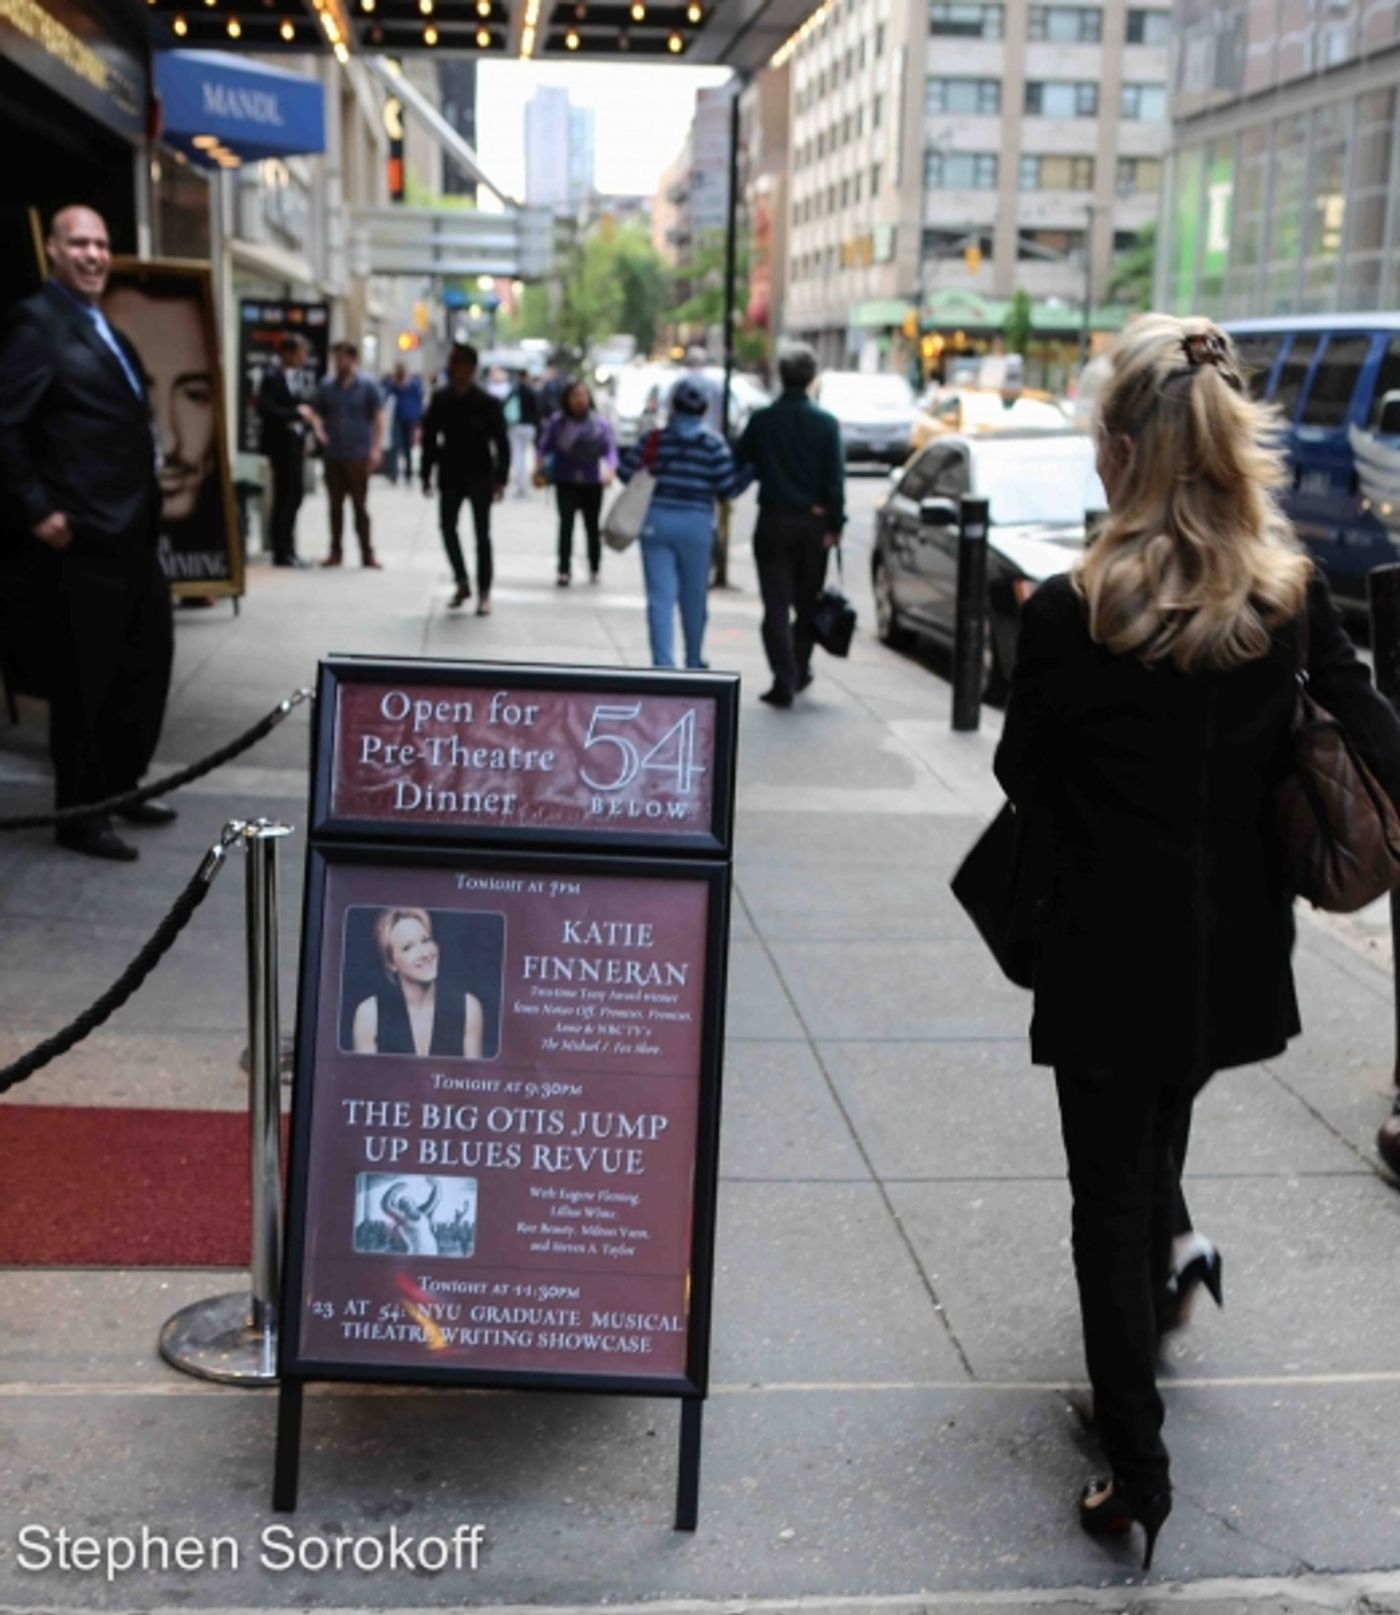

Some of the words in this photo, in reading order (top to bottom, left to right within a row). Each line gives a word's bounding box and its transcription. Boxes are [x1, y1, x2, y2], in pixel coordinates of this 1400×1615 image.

[380, 691, 475, 733] Open
[488, 691, 540, 726] for
[359, 734, 556, 771] Pre-Theatre
[579, 701, 706, 793] 54
[394, 777, 518, 815] Dinner
[591, 797, 689, 819] BELOW
[562, 920, 655, 948] KATIE
[522, 955, 689, 987] FINNERAN
[341, 1099, 413, 1127] THE
[420, 1103, 479, 1131] BIG
[486, 1107, 565, 1136] OTIS
[571, 1111, 669, 1140] JUMP
[363, 1136, 409, 1163] UP
[417, 1139, 522, 1169] BLUES
[531, 1144, 645, 1175] REVUE
[312, 1302, 335, 1320] 23
[343, 1299, 370, 1316] AT
[417, 1302, 462, 1321] NYU
[469, 1305, 581, 1327] GRADUATE
[590, 1311, 683, 1332] MUSICAL
[440, 1327, 533, 1348] WRITING
[537, 1332, 653, 1353] SHOWCASE
